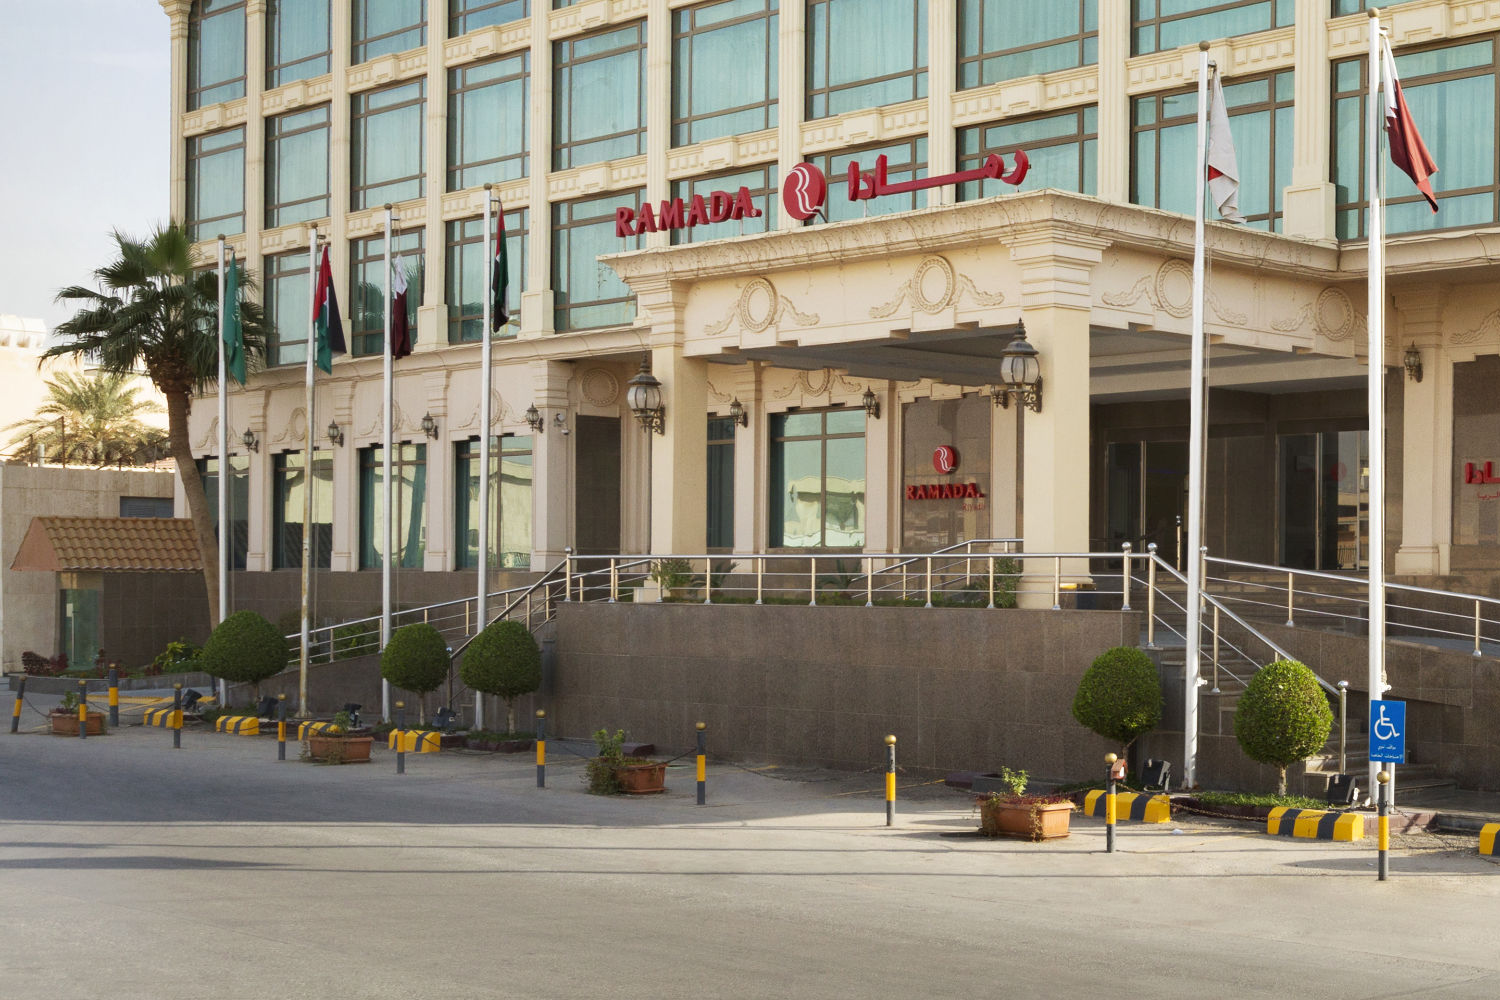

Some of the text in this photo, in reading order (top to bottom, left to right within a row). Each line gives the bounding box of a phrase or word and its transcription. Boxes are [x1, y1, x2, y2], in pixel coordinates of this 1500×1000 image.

[848, 149, 1030, 202] رمادا
[616, 186, 755, 238] RAMADA
[906, 483, 978, 500] RAMADA
